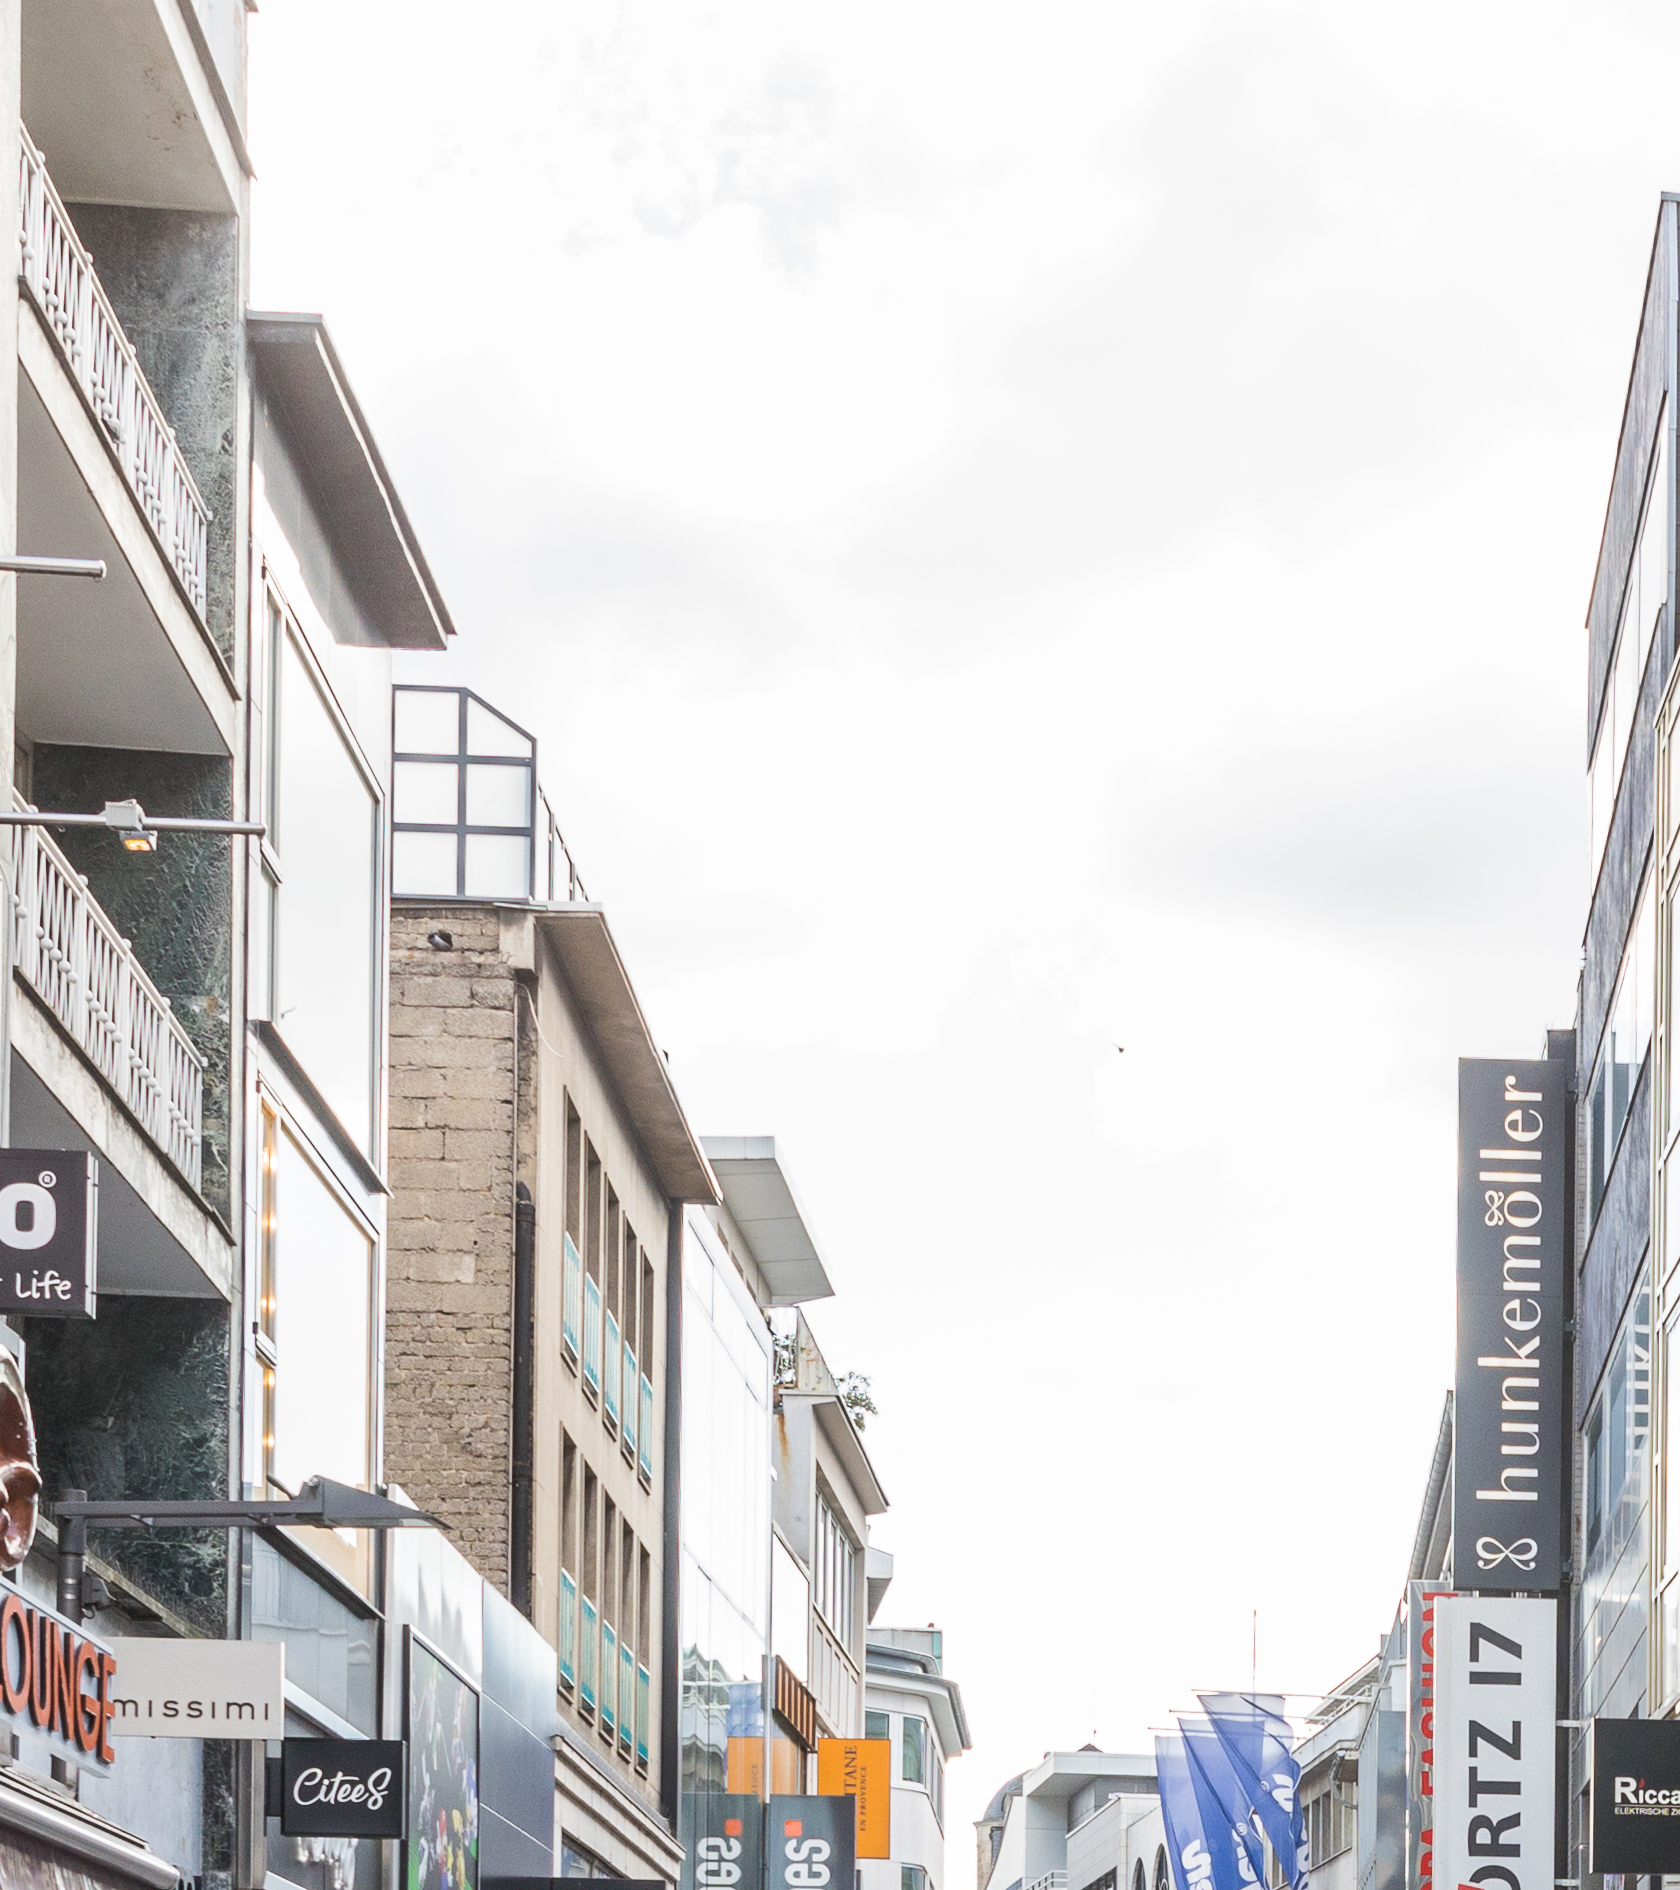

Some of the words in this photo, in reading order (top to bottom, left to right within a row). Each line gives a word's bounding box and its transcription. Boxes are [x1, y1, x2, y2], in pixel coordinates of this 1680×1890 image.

[15, 1269, 73, 1300] Life
[1476, 1074, 1545, 1501] hunkemöller
[1614, 1807, 1670, 1817] ELEKTRISCHE
